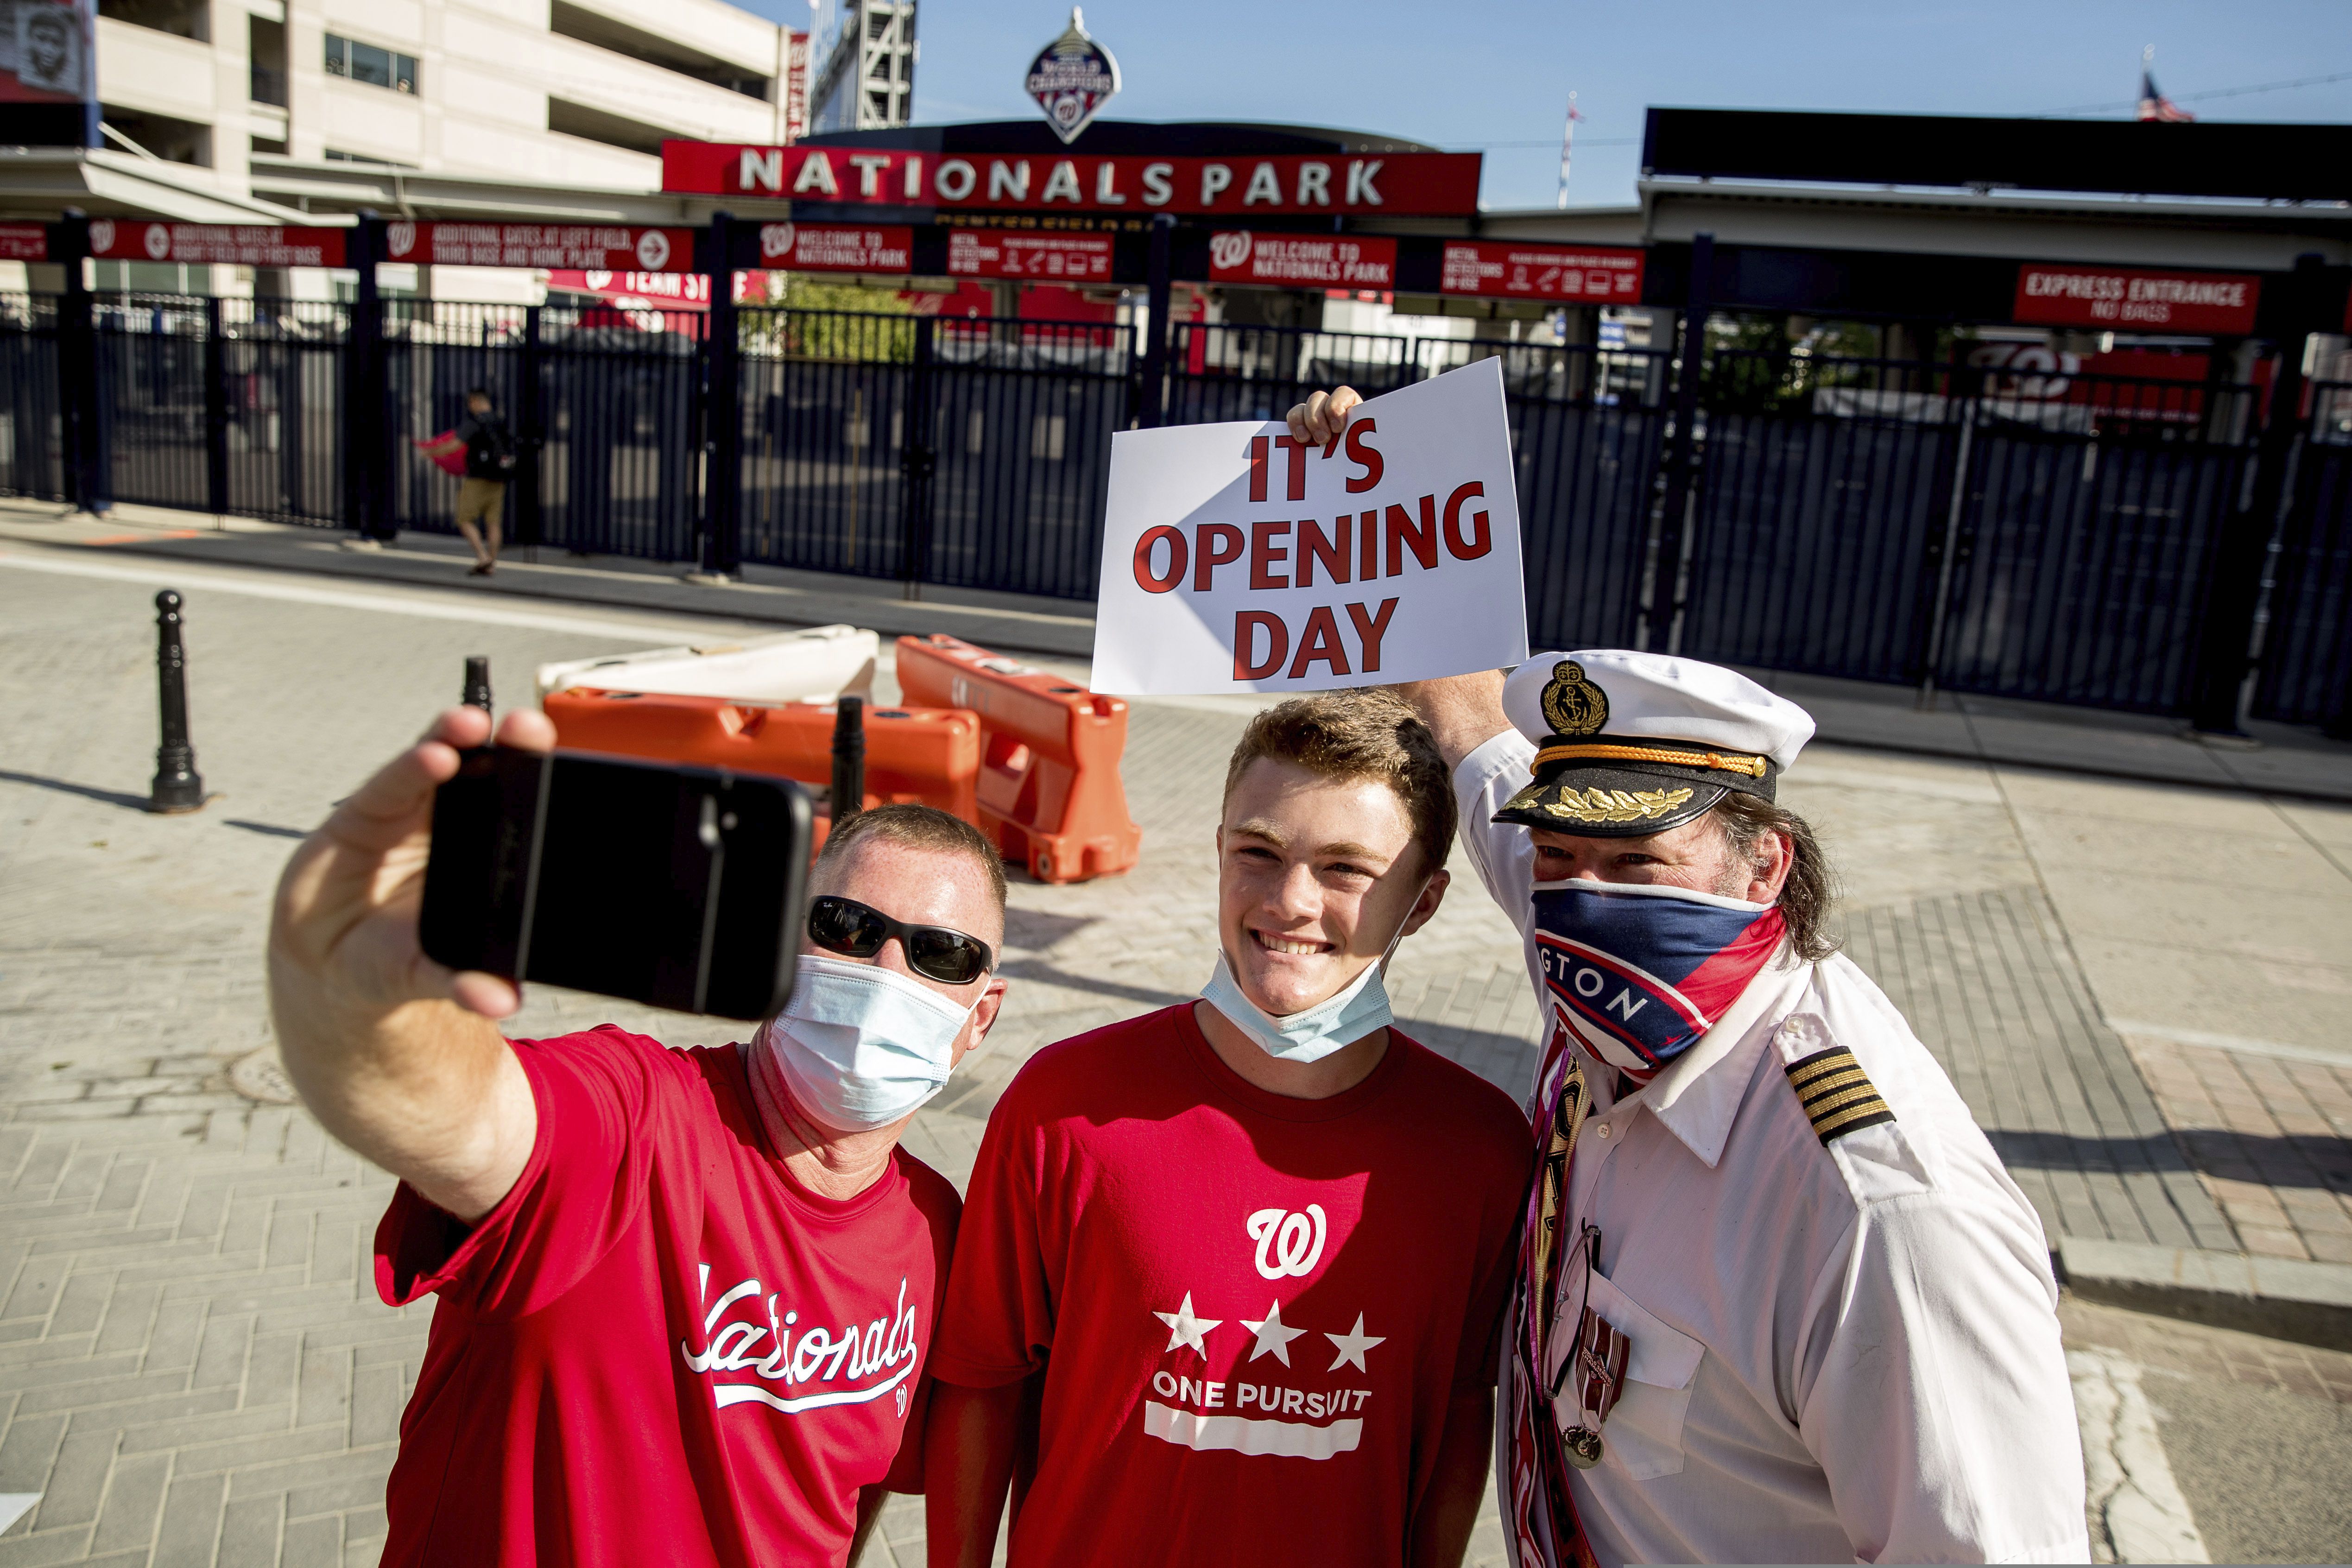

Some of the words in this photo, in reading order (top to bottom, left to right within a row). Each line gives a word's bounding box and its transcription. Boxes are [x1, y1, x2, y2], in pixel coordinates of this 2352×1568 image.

[740, 148, 1174, 206] NATIONALS
[1200, 159, 1385, 206] PARK
[795, 247, 868, 266] NATIONALS
[869, 248, 907, 267] PARK
[796, 230, 861, 248] WELCOME
[865, 231, 883, 249] TO
[1254, 240, 1334, 262] WELCOME
[1338, 243, 1360, 263] TO
[1252, 258, 1340, 281] NATIONALS
[1343, 261, 1389, 283] PARK
[2025, 272, 2126, 300] EXPRESS
[2127, 278, 2247, 307] ENTRANCE
[2090, 299, 2120, 320] NO
[2120, 300, 2172, 323] BAGS
[1250, 417, 1384, 502] IT'S
[1133, 481, 1492, 594] OPENING
[1233, 597, 1400, 681] DAY
[1153, 1371, 1226, 1407] ONE
[1237, 1382, 1372, 1418] PURSUIT
